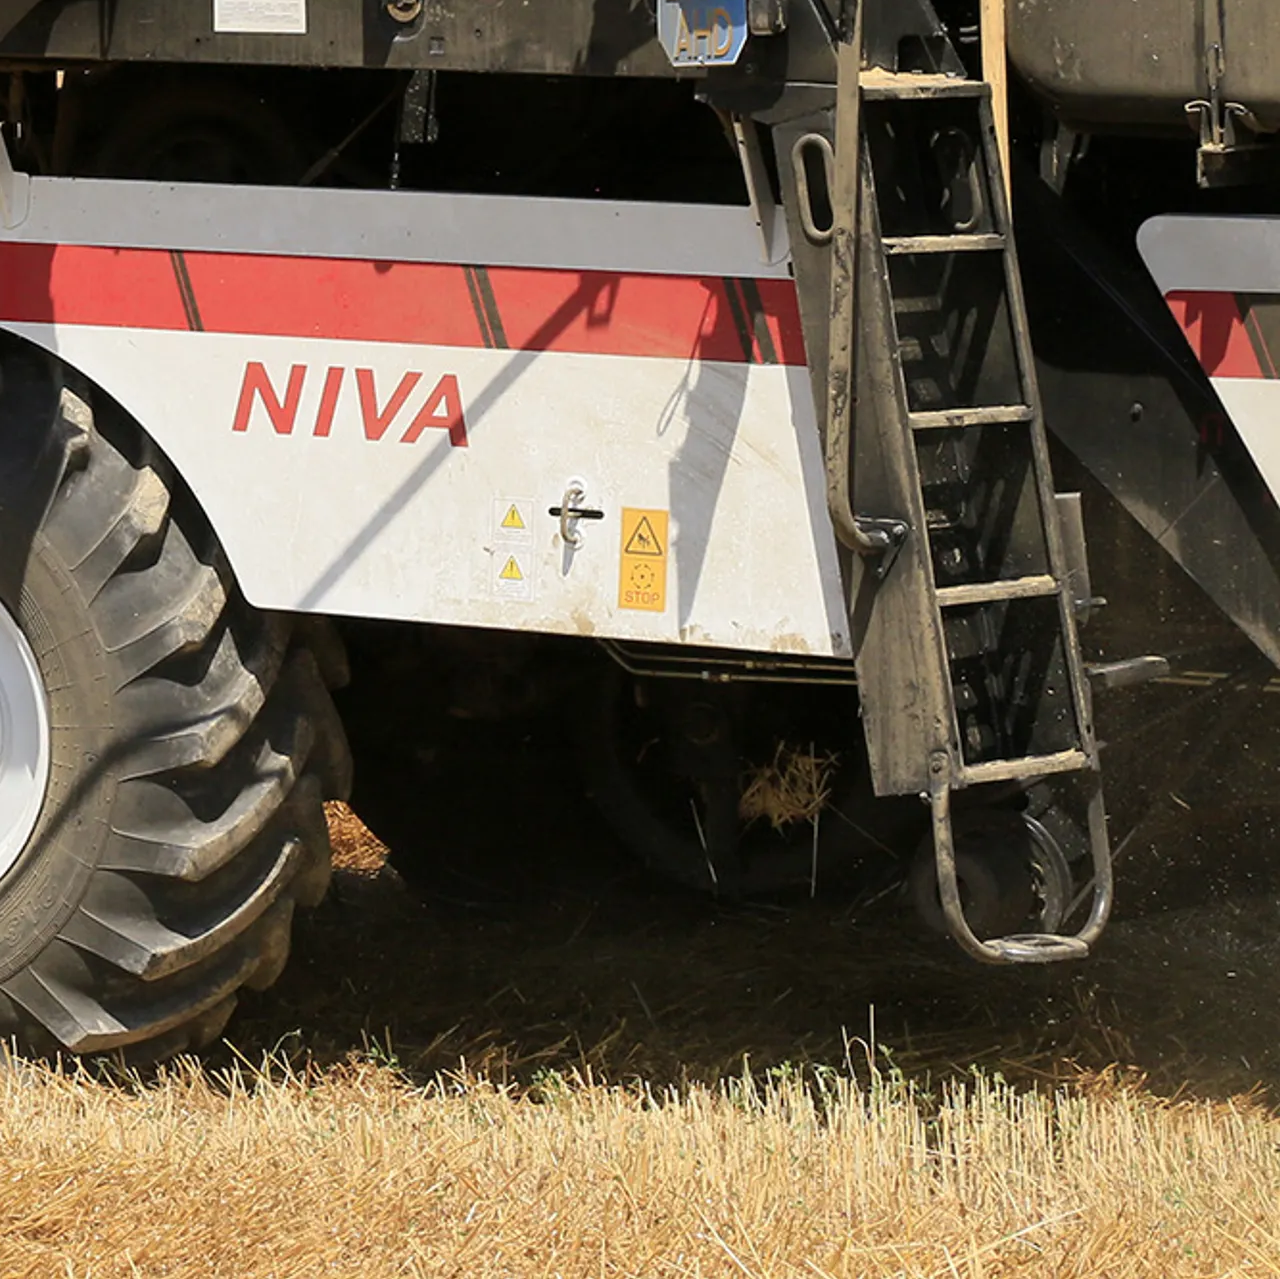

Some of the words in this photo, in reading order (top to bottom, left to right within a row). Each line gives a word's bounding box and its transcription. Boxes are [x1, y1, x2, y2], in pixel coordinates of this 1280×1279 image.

[673, 8, 733, 57] AHD
[232, 361, 469, 448] NIVA
[624, 589, 660, 605] STOP
